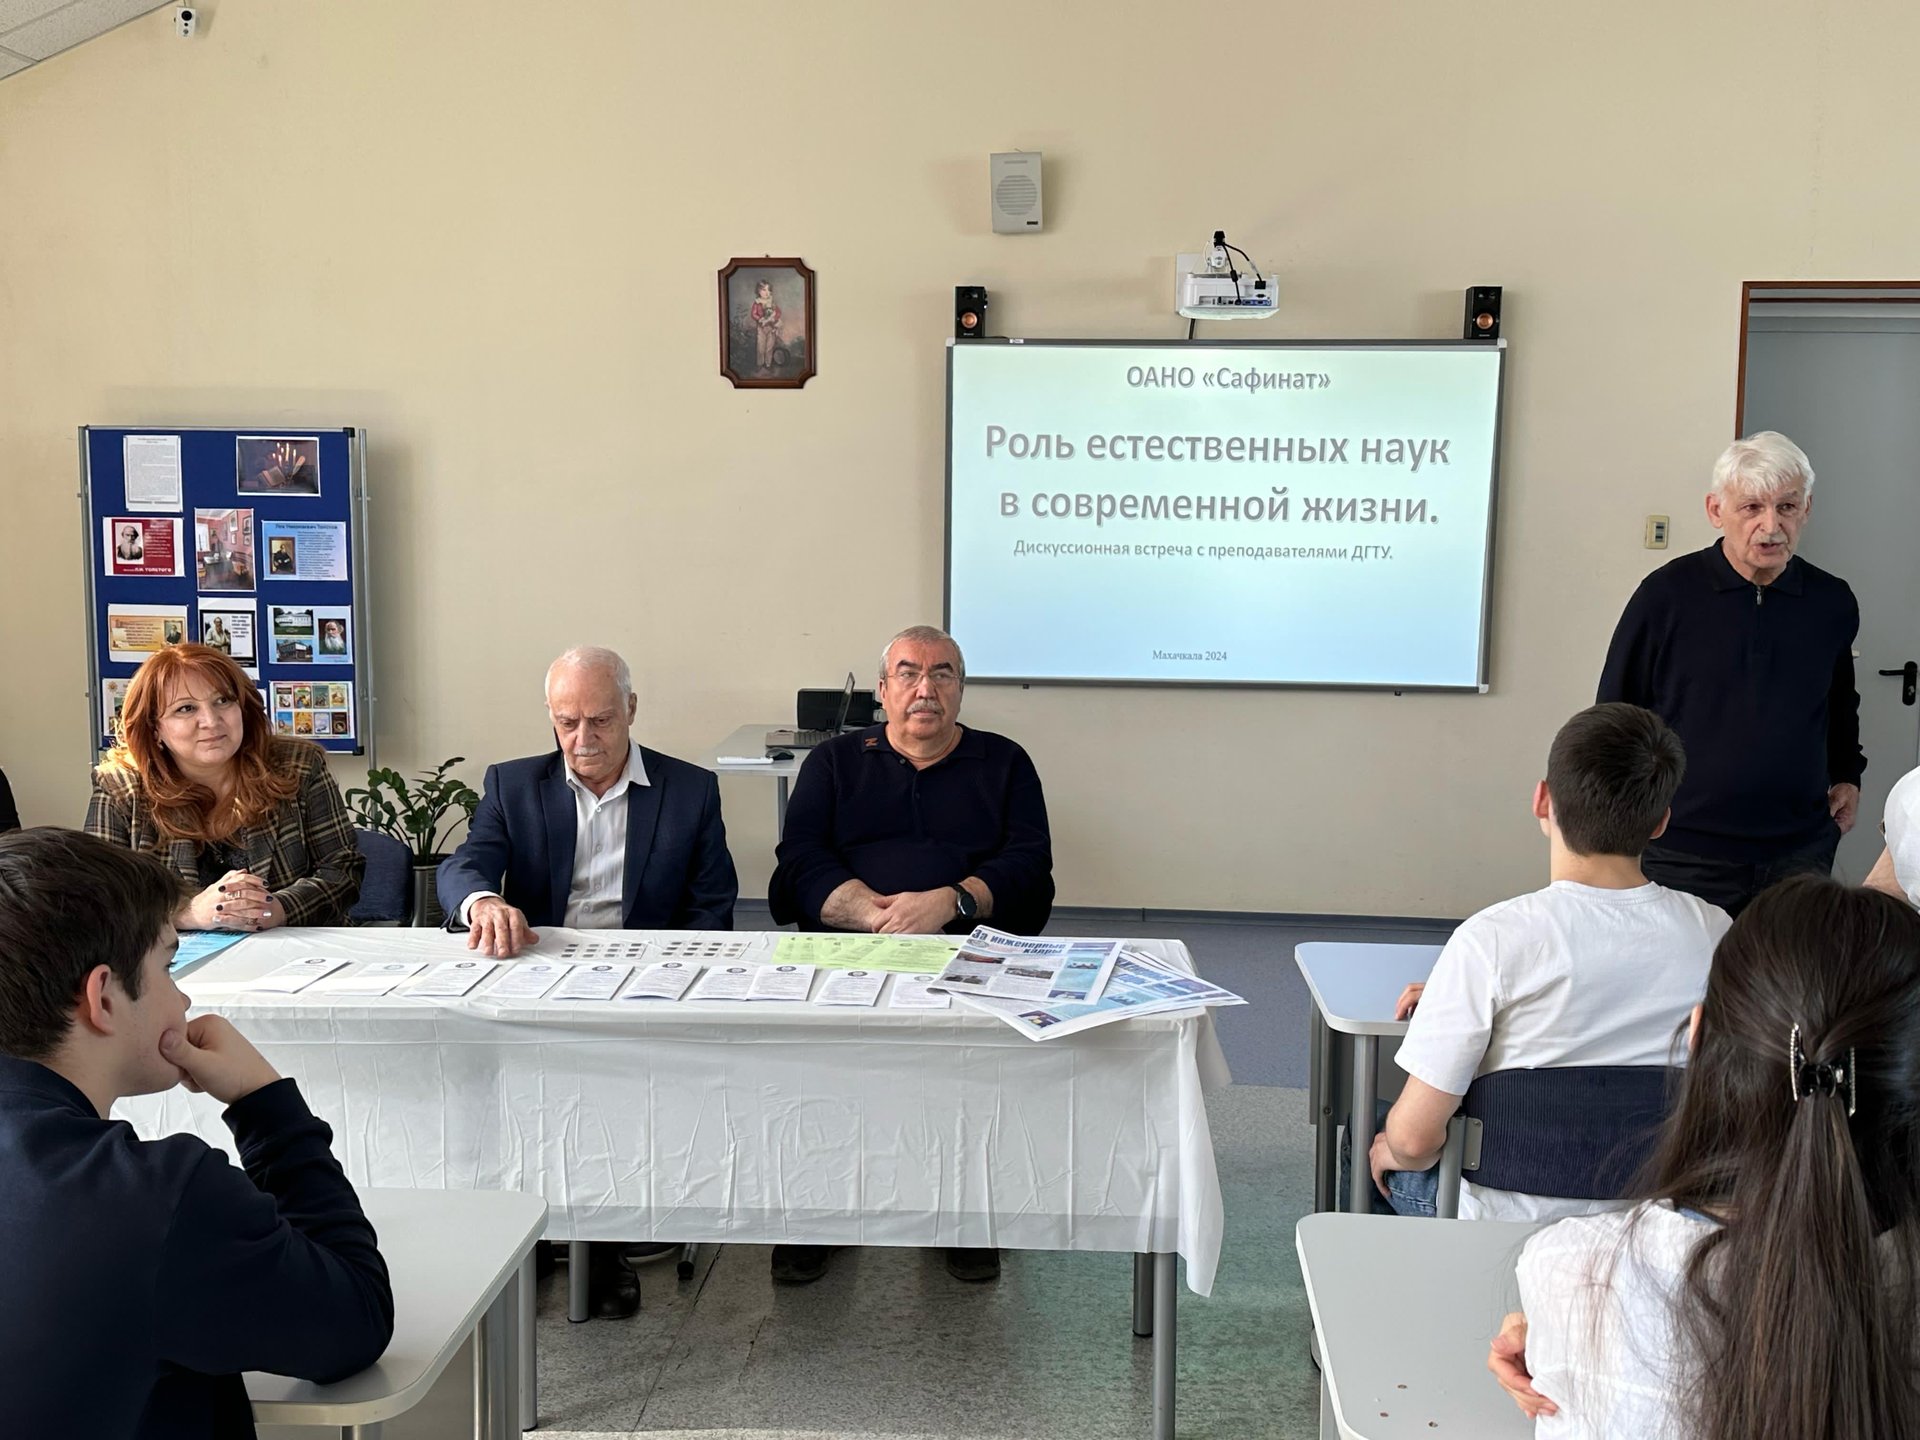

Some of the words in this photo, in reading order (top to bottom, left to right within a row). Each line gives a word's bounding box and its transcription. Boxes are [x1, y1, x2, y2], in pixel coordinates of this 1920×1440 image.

[1126, 366, 1196, 389] ОАНО
[1202, 367, 1332, 395] «Сафинат»
[986, 425, 1076, 460] Роль
[1087, 434, 1350, 465] естественных
[1361, 438, 1451, 474] наук
[1000, 492, 1019, 517] в
[1031, 486, 1290, 528] современной
[1302, 497, 1439, 525] жизни.
[1013, 539, 1130, 558] Дискуссионная
[1134, 544, 1193, 559] встреча
[1197, 545, 1205, 557] с
[1208, 545, 1348, 561] преподавателями
[1351, 545, 1393, 562] ДГТУ.
[1152, 649, 1203, 661] Махачкала
[1205, 650, 1228, 661] 2024
[972, 928, 989, 941] За
[990, 935, 1067, 949] инженерные
